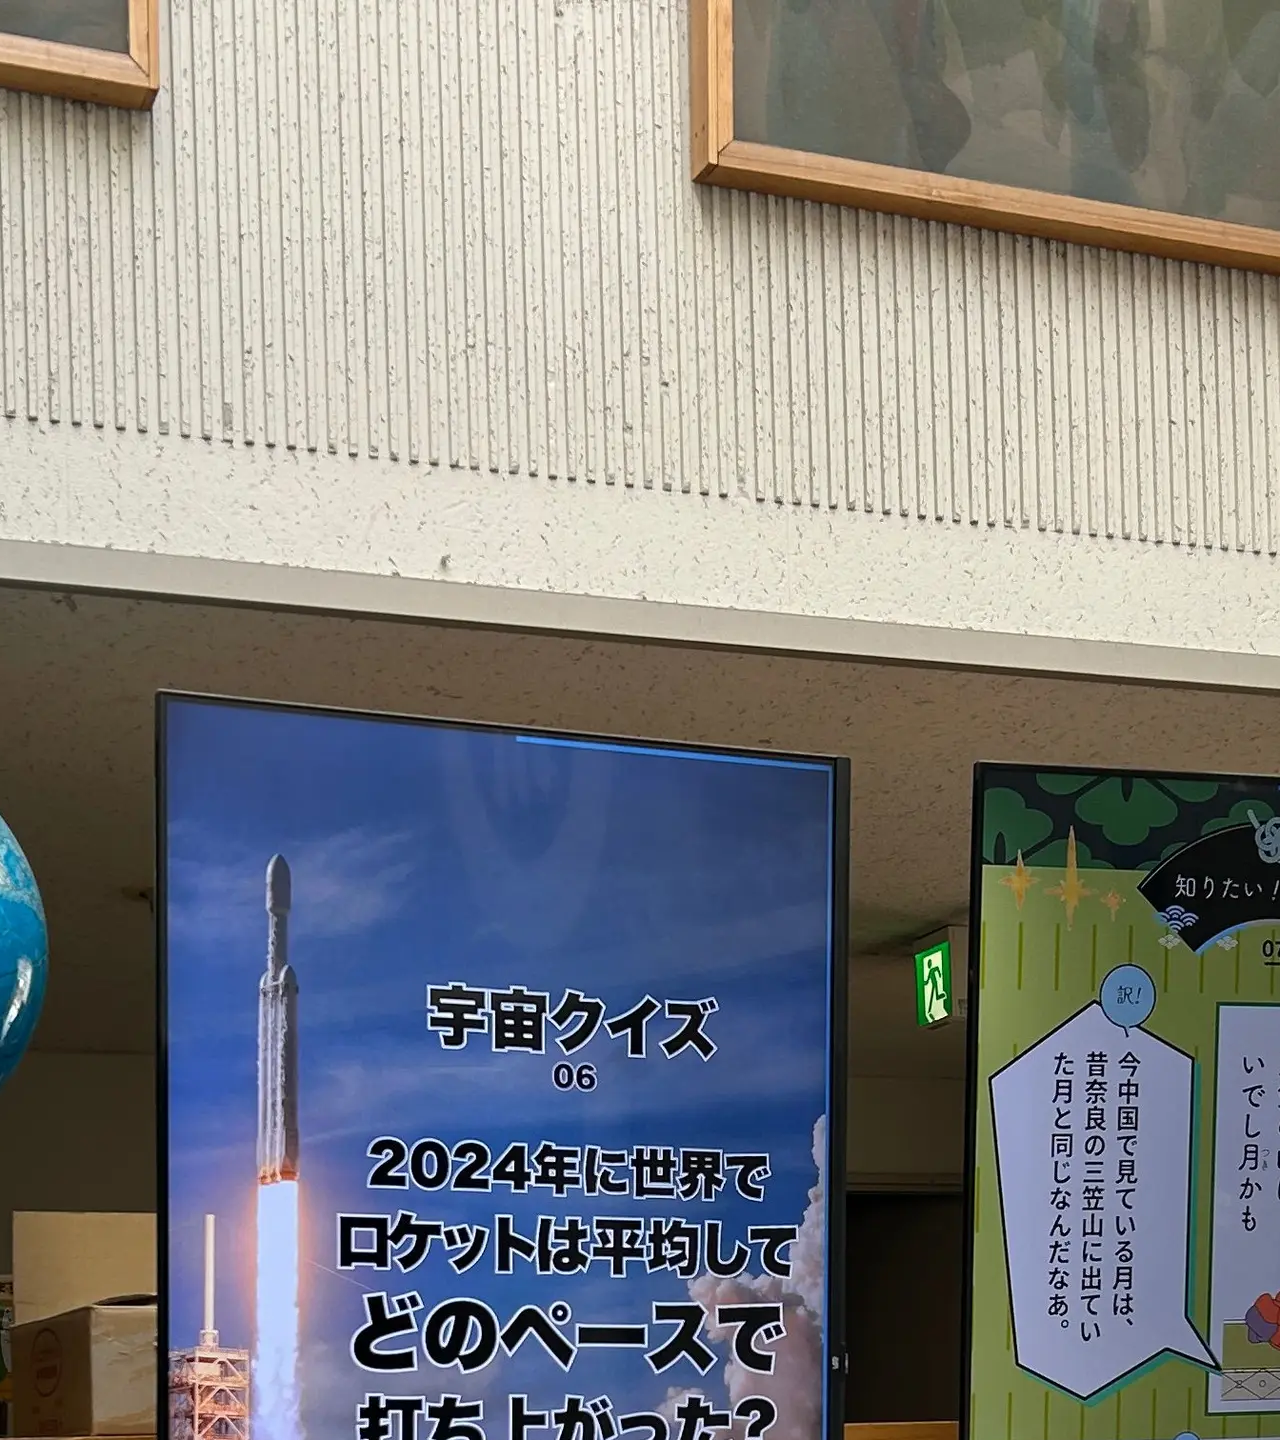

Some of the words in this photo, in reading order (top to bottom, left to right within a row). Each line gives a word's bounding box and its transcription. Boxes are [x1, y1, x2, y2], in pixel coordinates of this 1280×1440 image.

[425, 981, 720, 1062] 宇宙クイズ
[552, 1062, 597, 1092] 06
[366, 1137, 771, 1202] 2024年に世界で
[1238, 1056, 1266, 1231] いでし月かも
[1047, 1051, 1076, 1331] た月と同じなんだなあ。
[1080, 1050, 1110, 1342] 昔奈良の三笠山に出てい
[1111, 1051, 1142, 1328] 今中国で見ている月は、
[337, 1212, 800, 1278] ロケットは平均して
[350, 1292, 786, 1375] どのペースで
